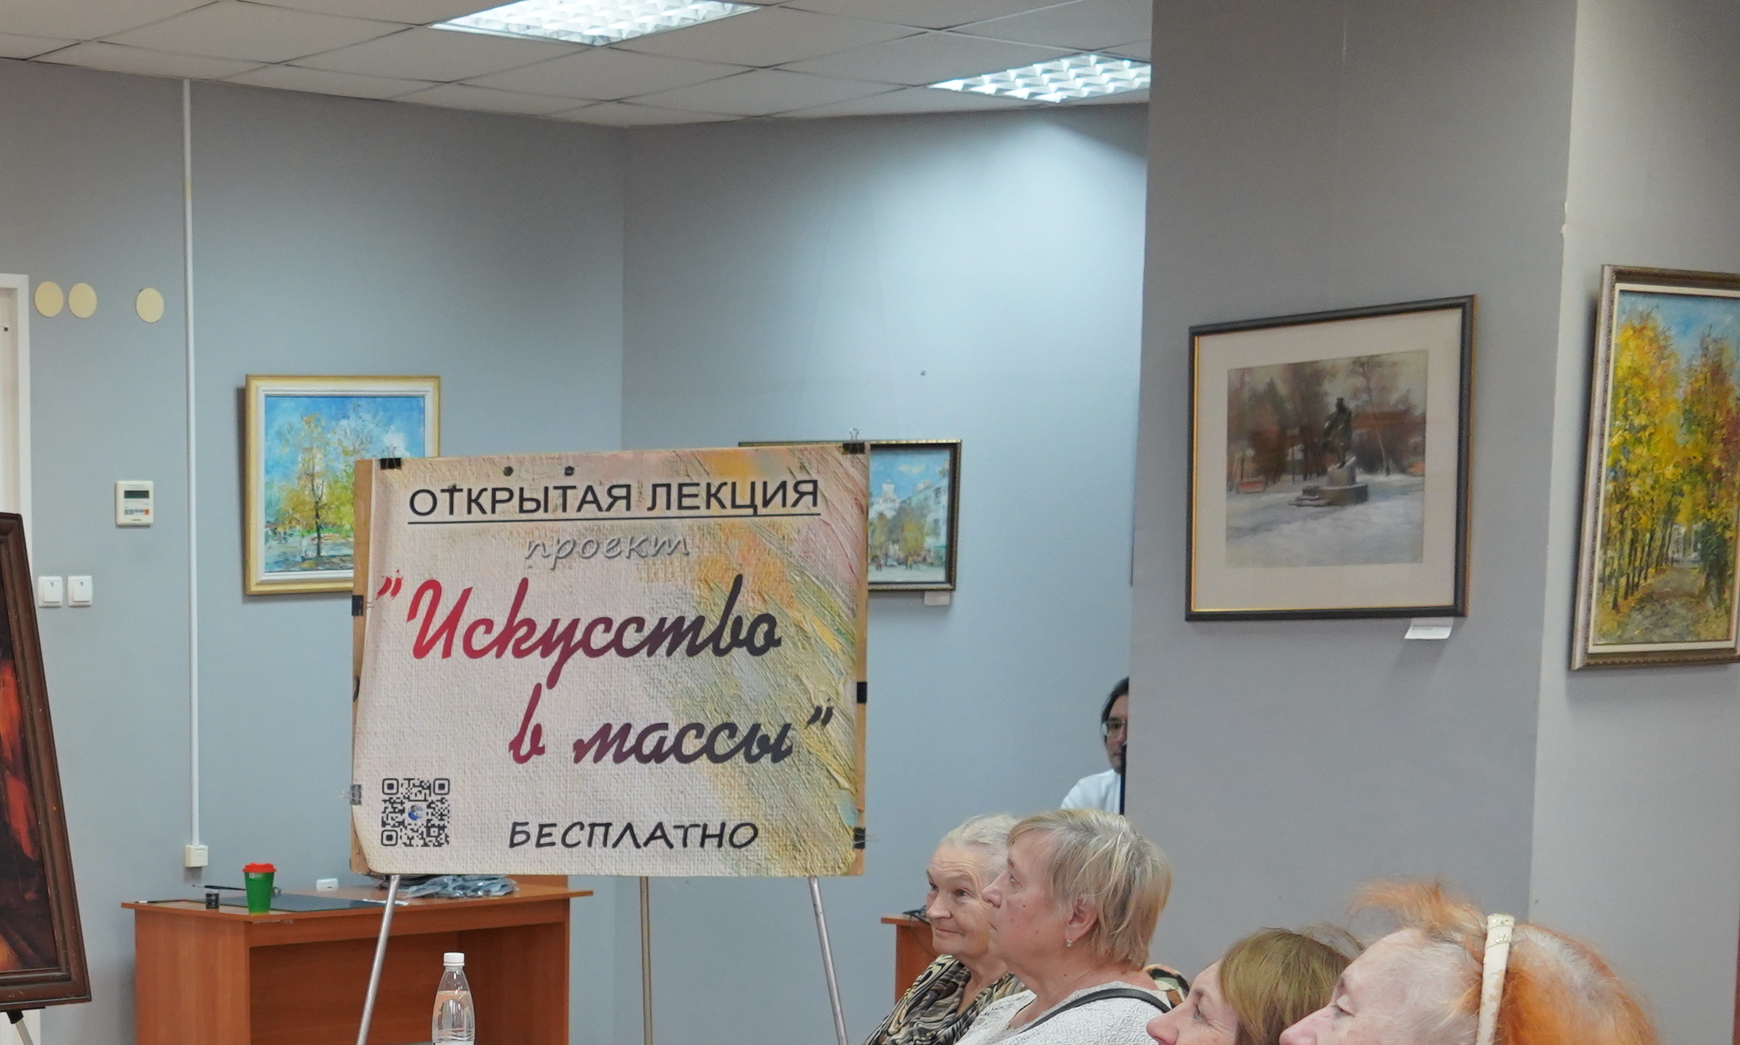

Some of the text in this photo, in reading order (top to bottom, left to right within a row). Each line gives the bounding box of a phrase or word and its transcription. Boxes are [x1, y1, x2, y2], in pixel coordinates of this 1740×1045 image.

[408, 479, 819, 517] ОТКРЫТАЯ ЛЕКЦИЯ
[524, 534, 690, 571] проект
[509, 682, 545, 765] в
[509, 821, 758, 849] БЕСПЛАТНО
